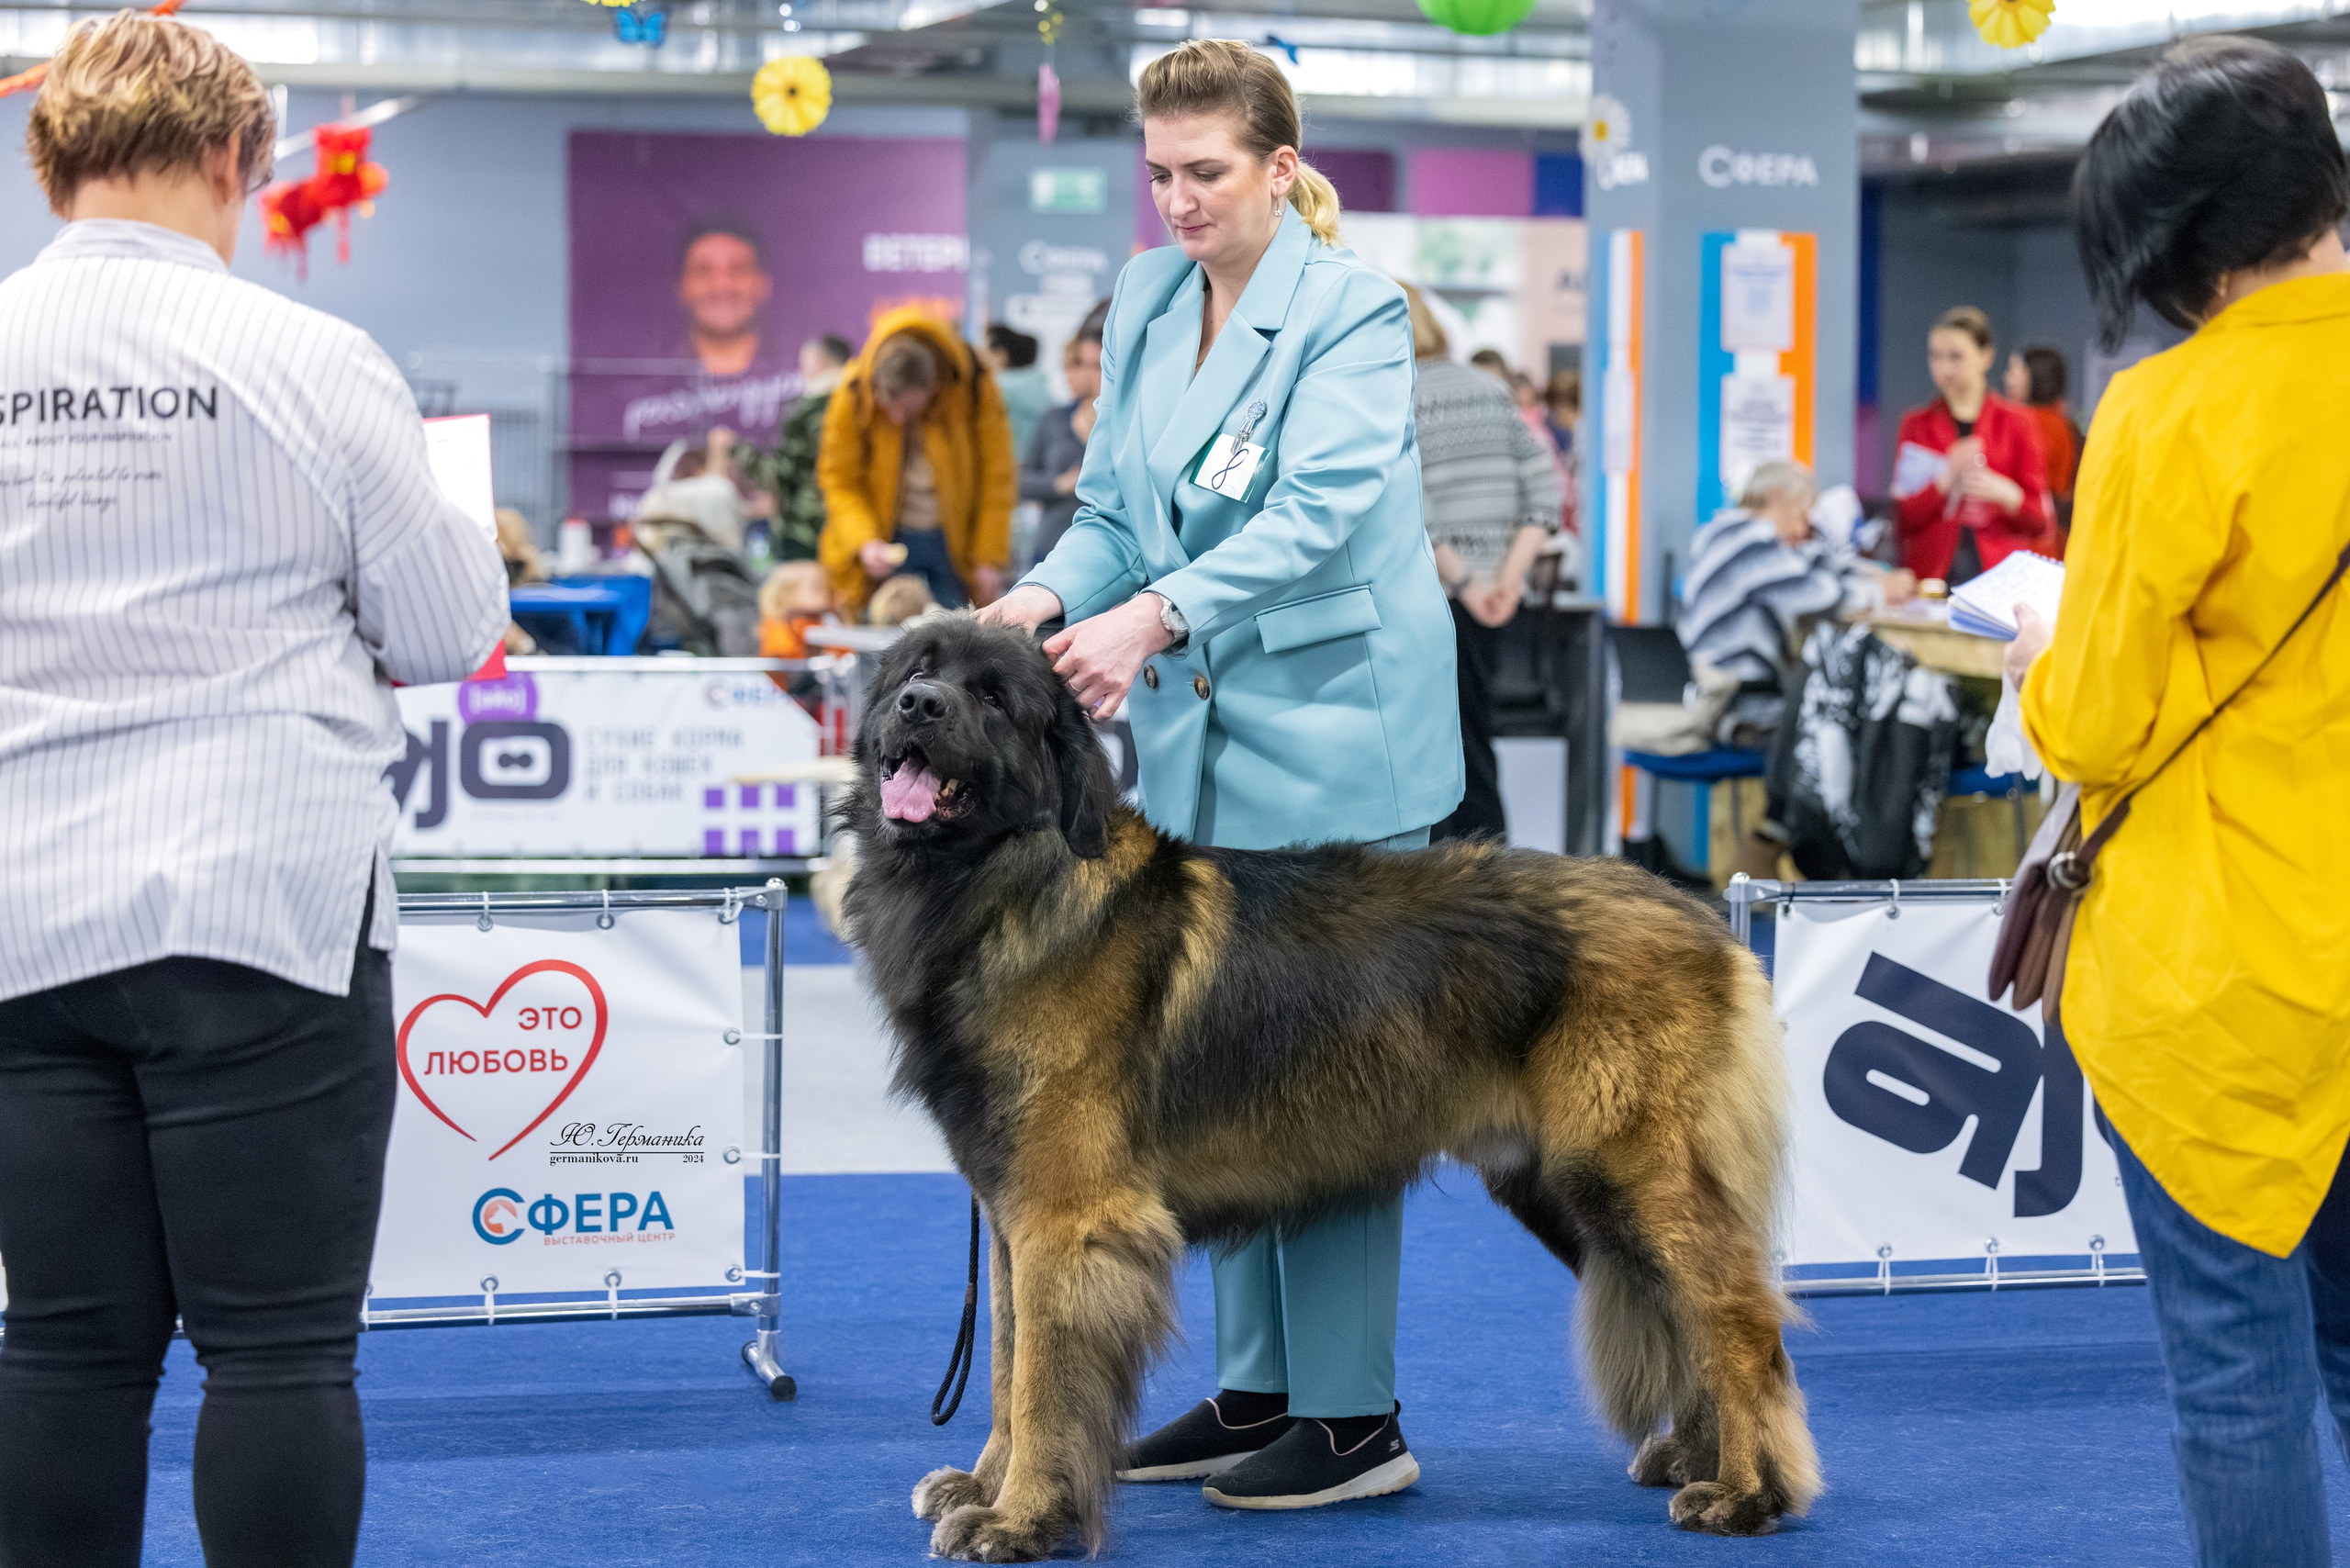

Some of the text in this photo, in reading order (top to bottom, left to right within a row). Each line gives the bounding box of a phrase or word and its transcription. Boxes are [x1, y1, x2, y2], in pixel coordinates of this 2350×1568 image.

[519, 1006, 582, 1030] ЭТО
[424, 1048, 568, 1075] ЛЮБОВЬ
[472, 1187, 675, 1246] СФЕРА
[543, 1232, 676, 1246] ВЫСТАВОЧНЫЙ ЦЕНТР
